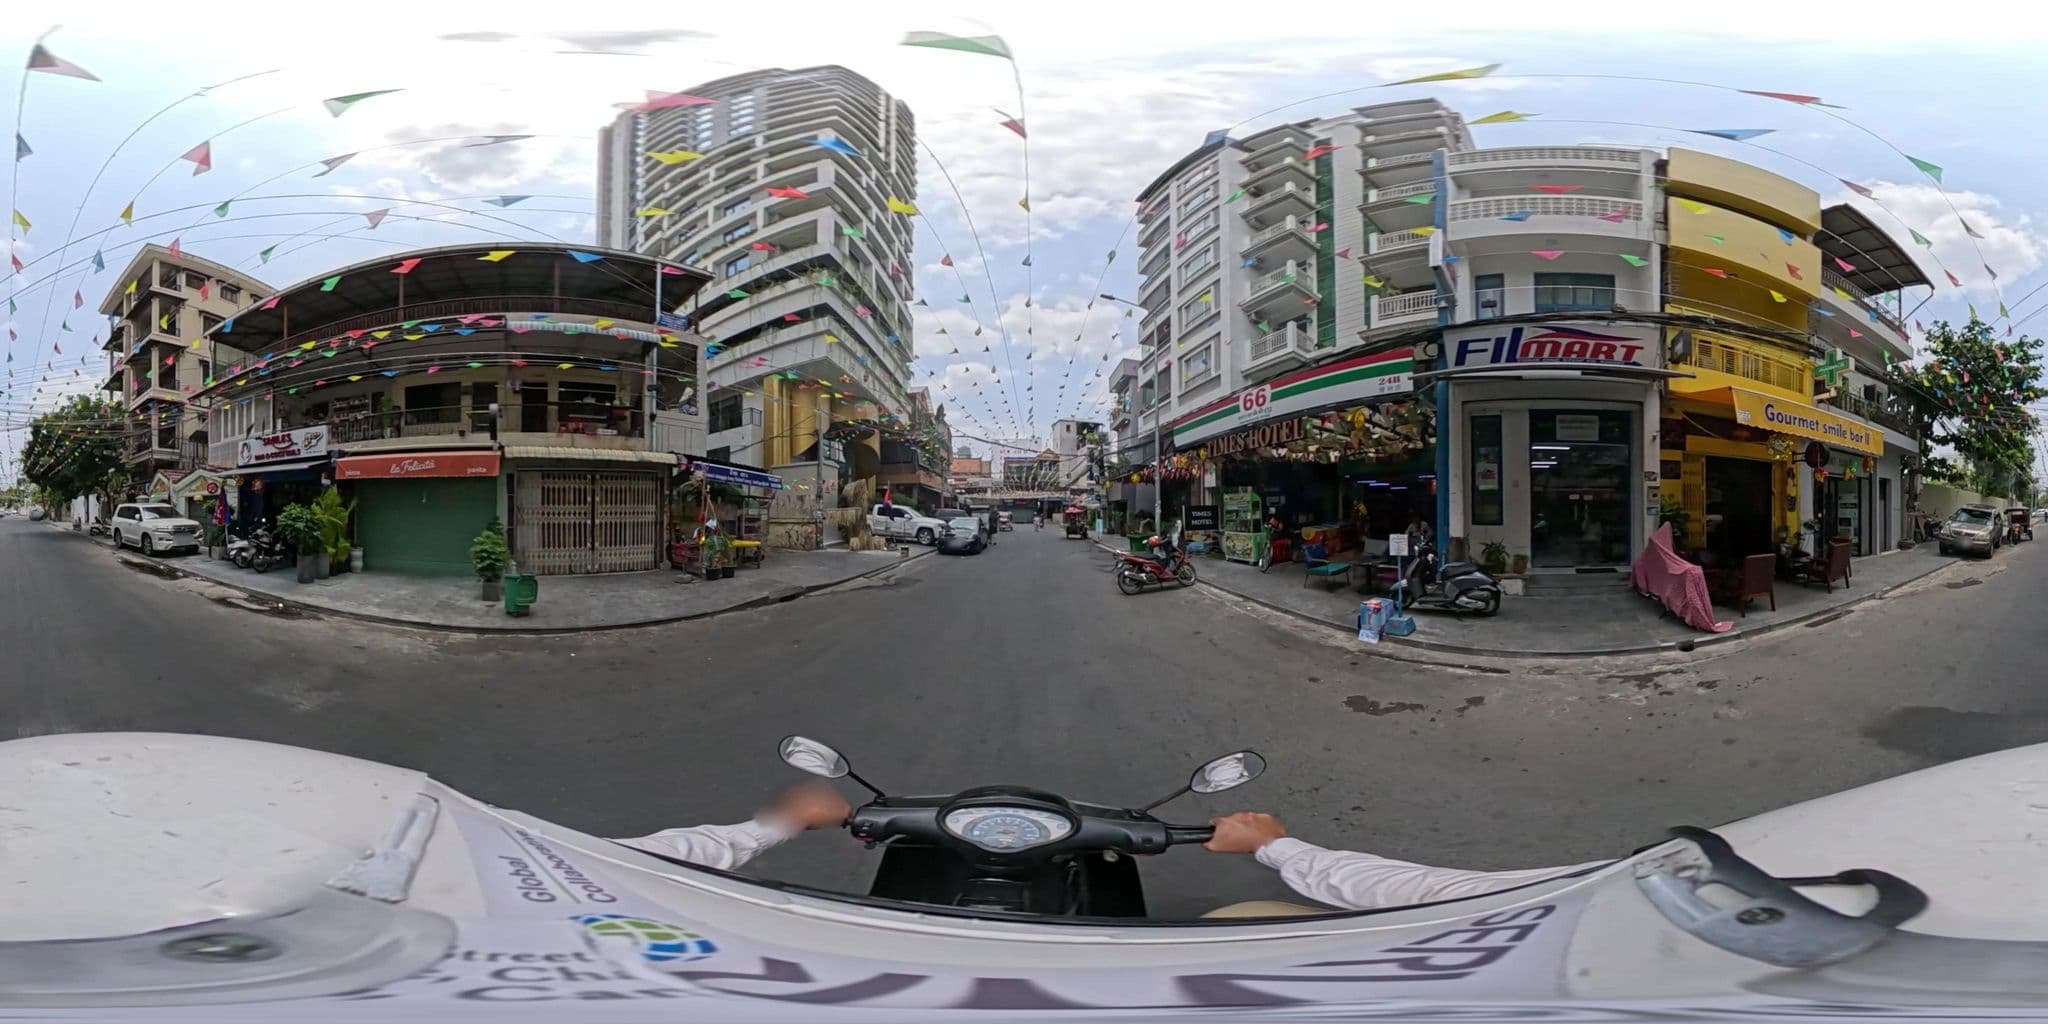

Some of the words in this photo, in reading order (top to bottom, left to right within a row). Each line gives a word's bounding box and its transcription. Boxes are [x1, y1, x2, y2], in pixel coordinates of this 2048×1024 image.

[1243, 387, 1267, 411] 66
[1207, 431, 1246, 458] TIMES
[1247, 418, 1305, 449] HOTEL
[1765, 403, 1819, 432] Gourmet
[1823, 423, 1848, 440] smile
[1849, 427, 1863, 443] bar
[389, 463, 400, 473] la
[497, 855, 557, 903] Global
